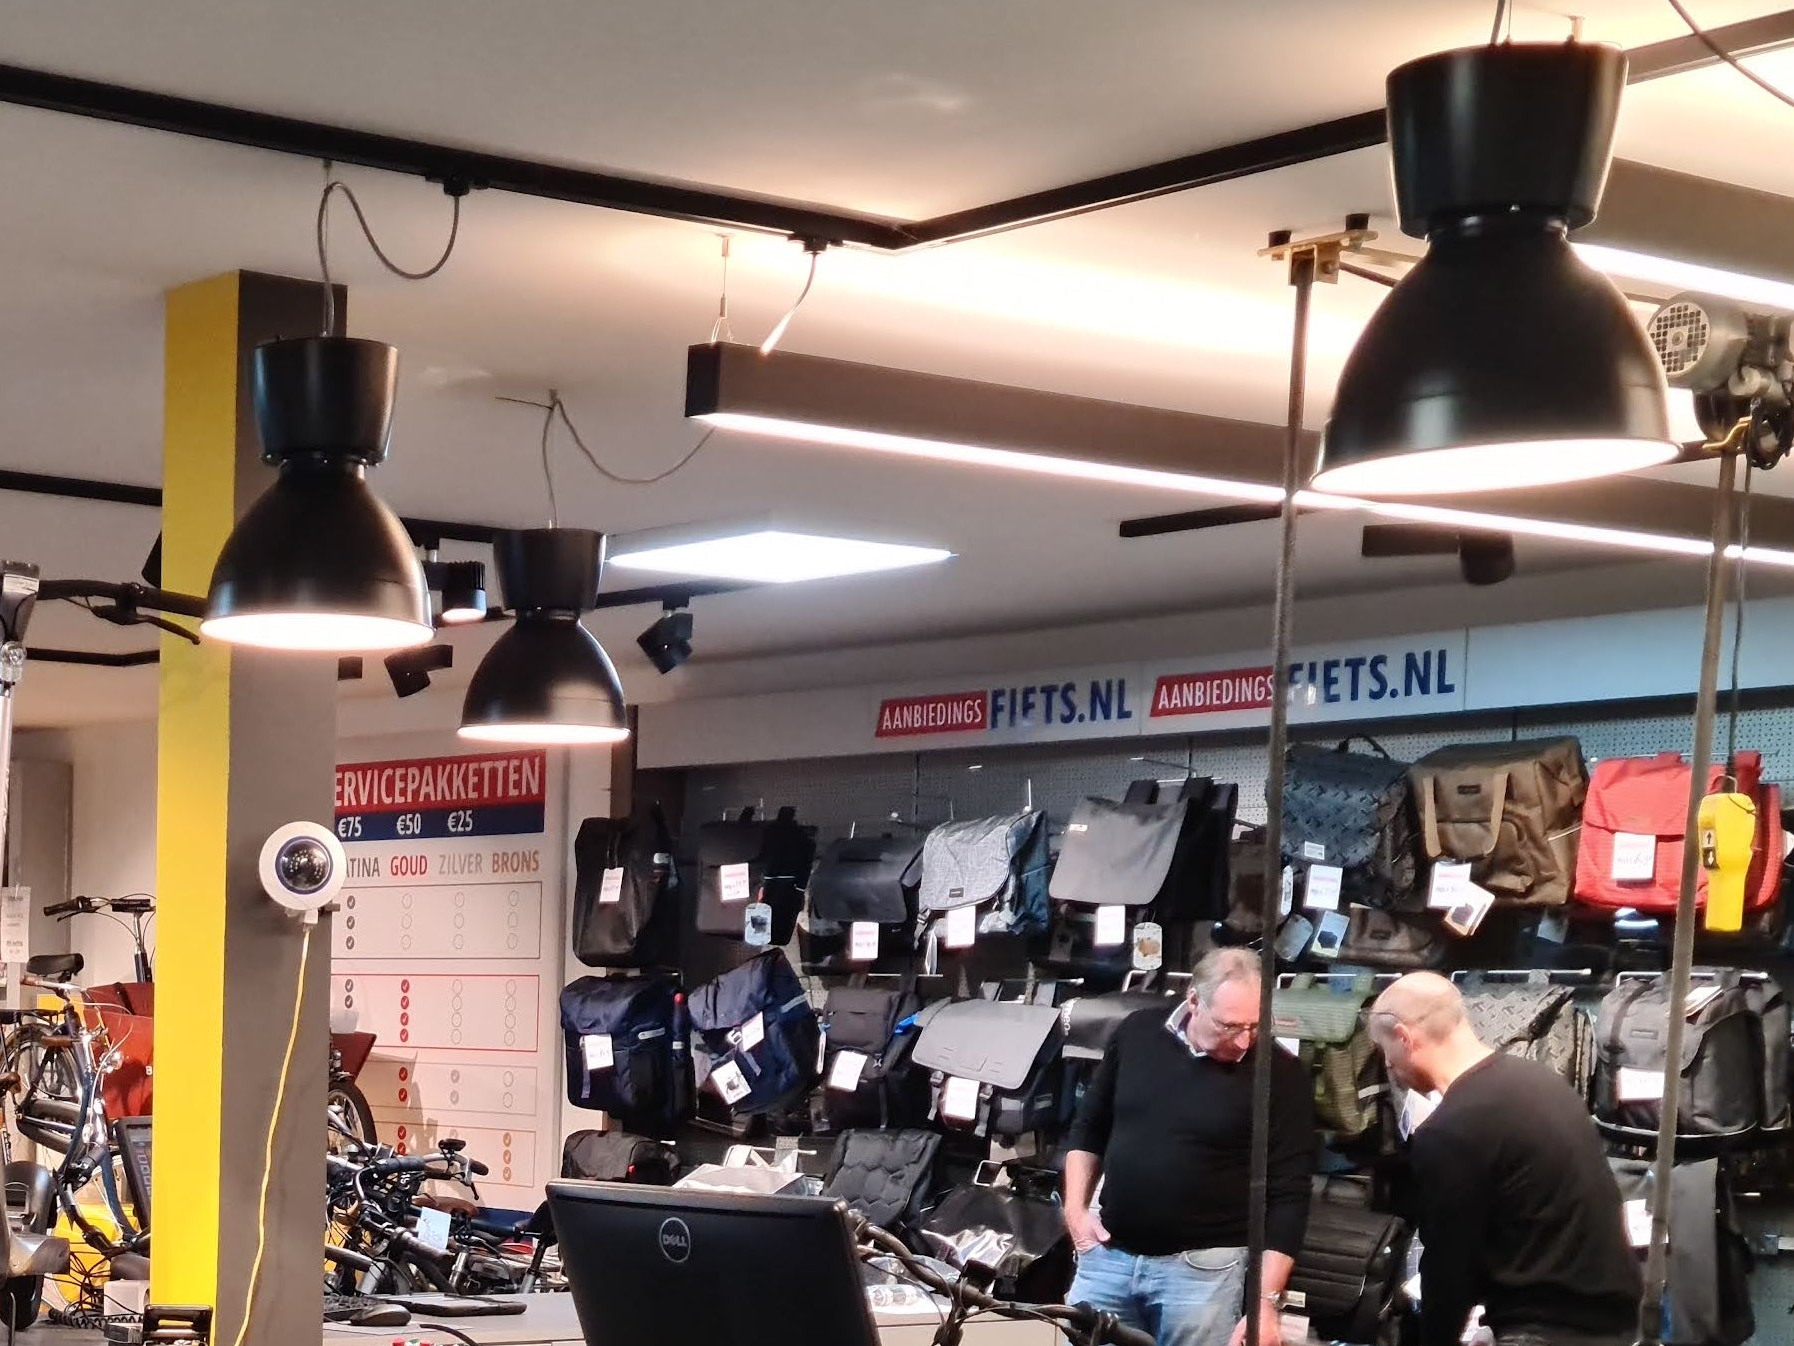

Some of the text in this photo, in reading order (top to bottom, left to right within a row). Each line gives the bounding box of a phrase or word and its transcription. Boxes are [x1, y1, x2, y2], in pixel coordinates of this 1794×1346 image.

[881, 679, 1134, 731] AANBIEDINGS FIETS.NL
[1158, 673, 1274, 711] AANBIEDINGS
[334, 756, 541, 807] ERVICEPAKKETTEN
[337, 809, 474, 838] €75 €50 €25
[346, 851, 540, 878] TINA GOUD ZILVER BRONS
[662, 1233, 688, 1247] DELL
